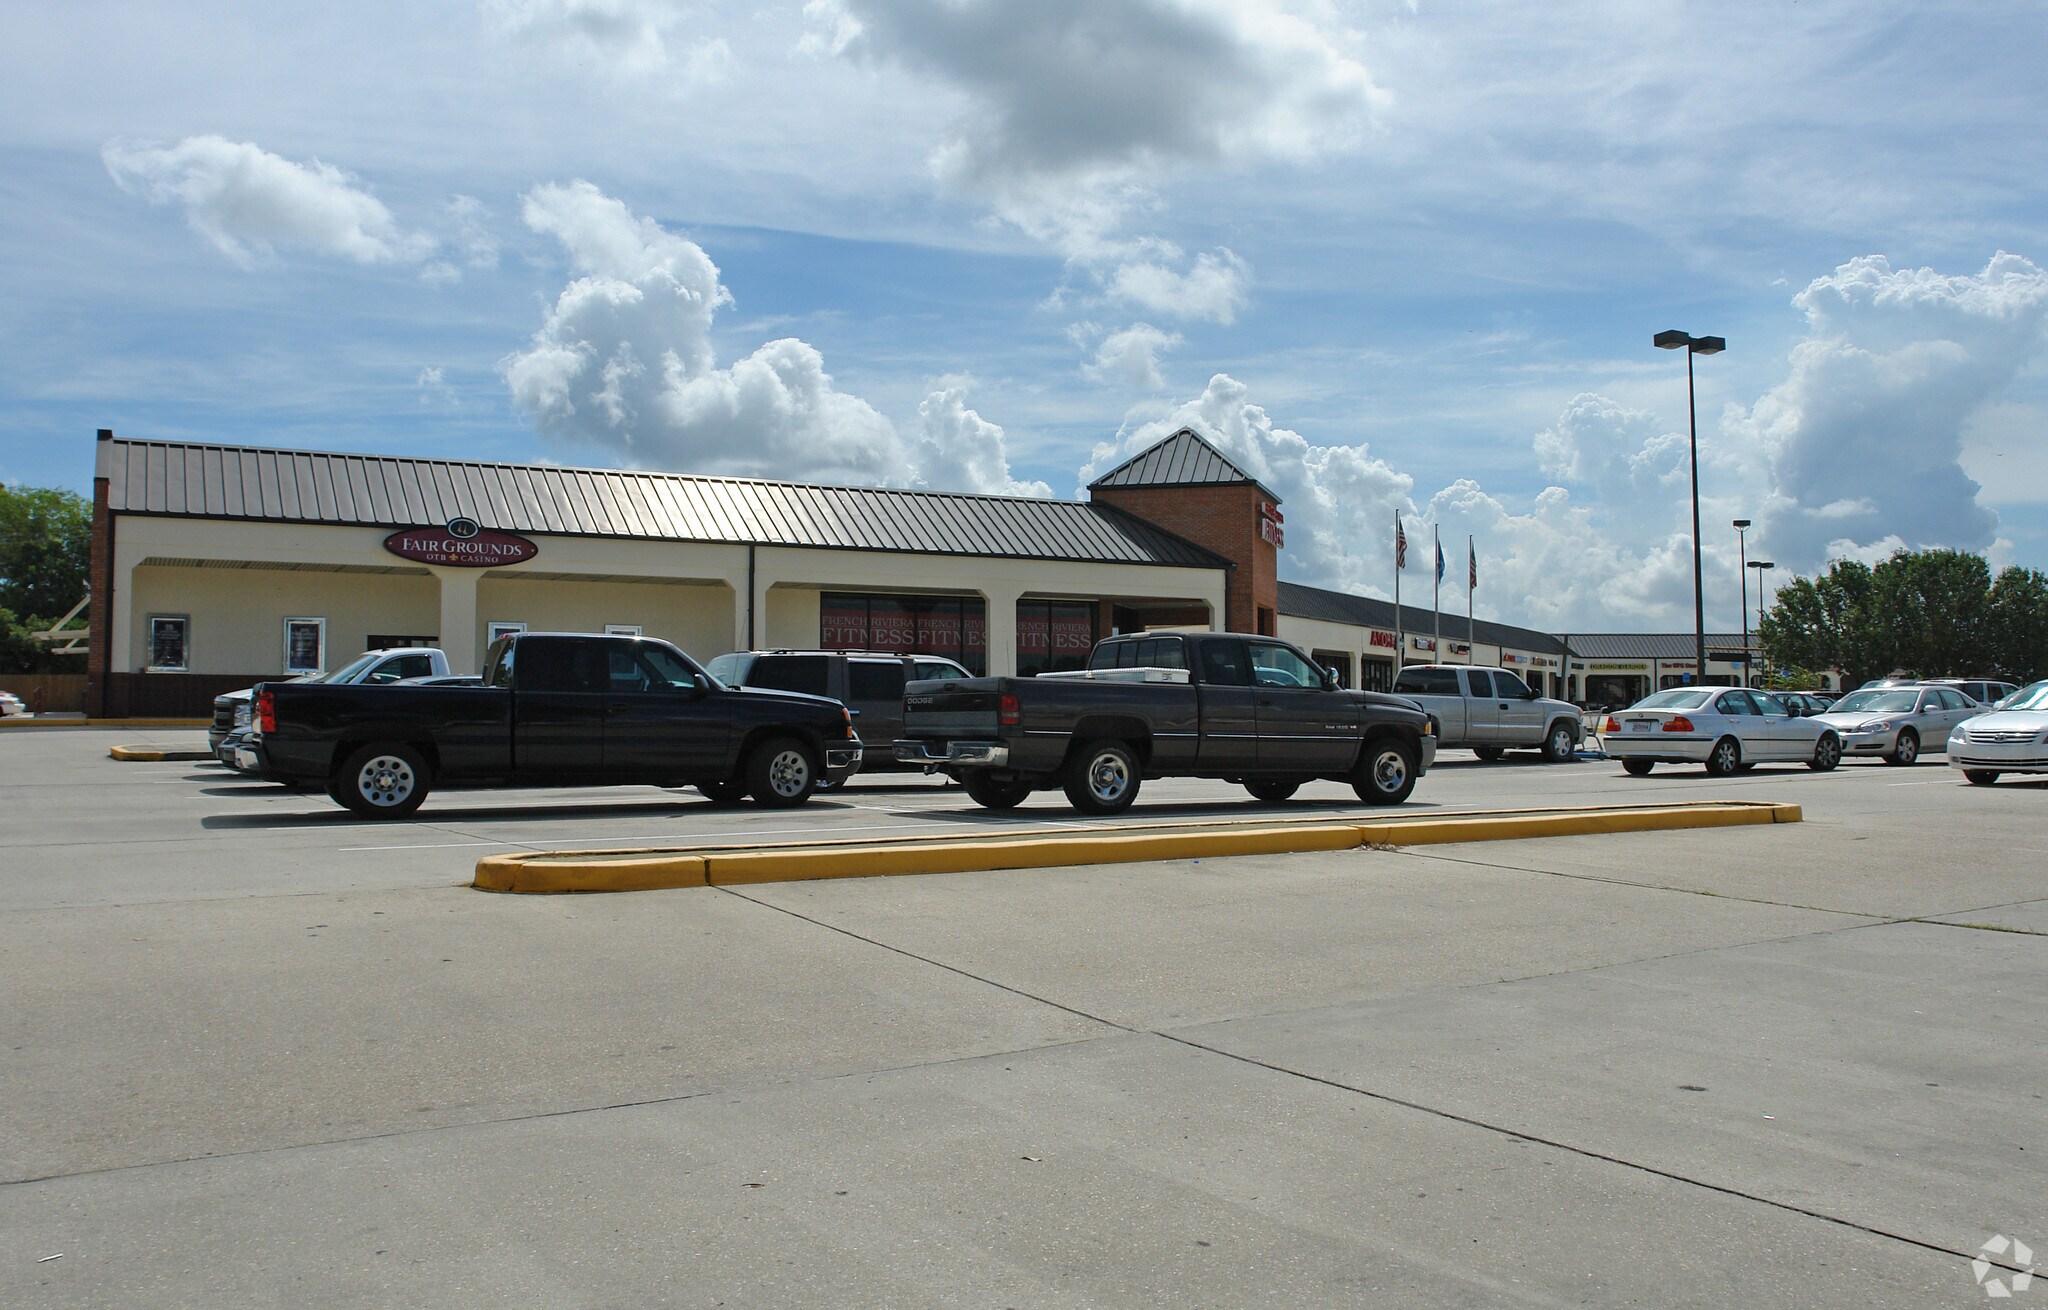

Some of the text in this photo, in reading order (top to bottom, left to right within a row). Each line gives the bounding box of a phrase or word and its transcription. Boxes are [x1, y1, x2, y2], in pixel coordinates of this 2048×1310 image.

[403, 538, 522, 556] FAIR GROUNDS
[426, 553, 499, 563] OTB CASINO
[822, 616, 914, 628] FRENCH RIVIERA
[917, 619, 961, 629] FRENCH
[1052, 623, 1091, 632] RIVIERA
[822, 627, 914, 645] FITNESS
[1016, 632, 1092, 649] ITNESS
